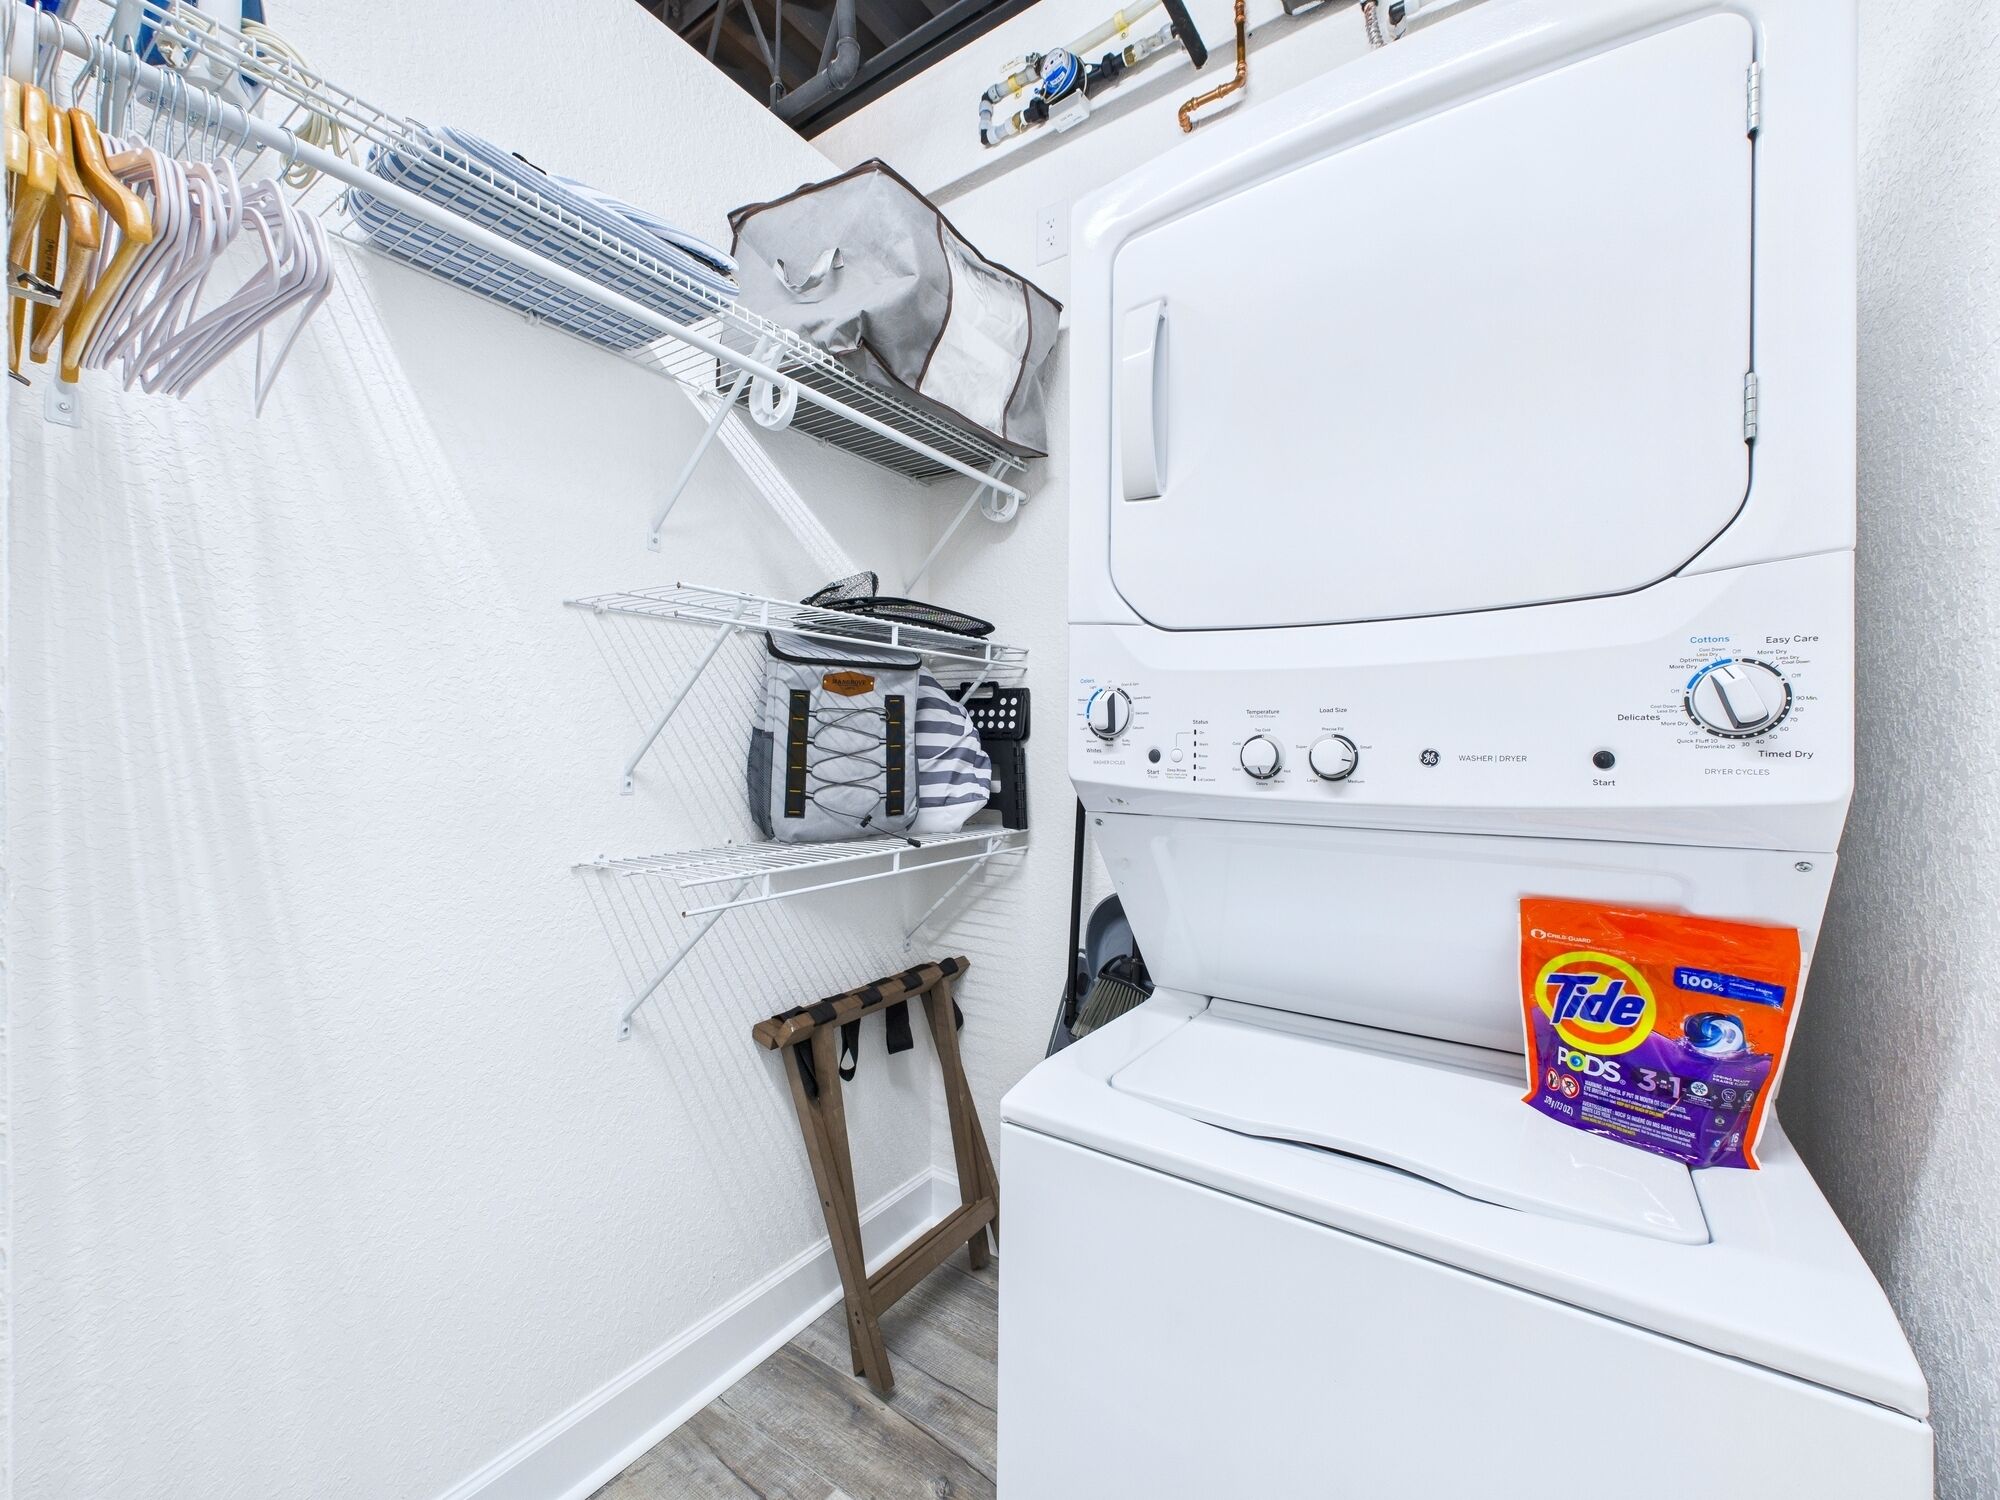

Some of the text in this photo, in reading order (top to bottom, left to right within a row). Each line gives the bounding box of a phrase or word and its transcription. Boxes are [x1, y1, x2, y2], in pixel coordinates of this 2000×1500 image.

[1766, 636, 1790, 644] Easy
[1421, 750, 1439, 766] GE
[1795, 750, 1814, 759] Dry
[1680, 974, 1724, 992] 100%
[1546, 972, 1646, 1026] Tide
[1558, 1046, 1621, 1082] PODS
[1563, 1104, 1573, 1116] OZ)
